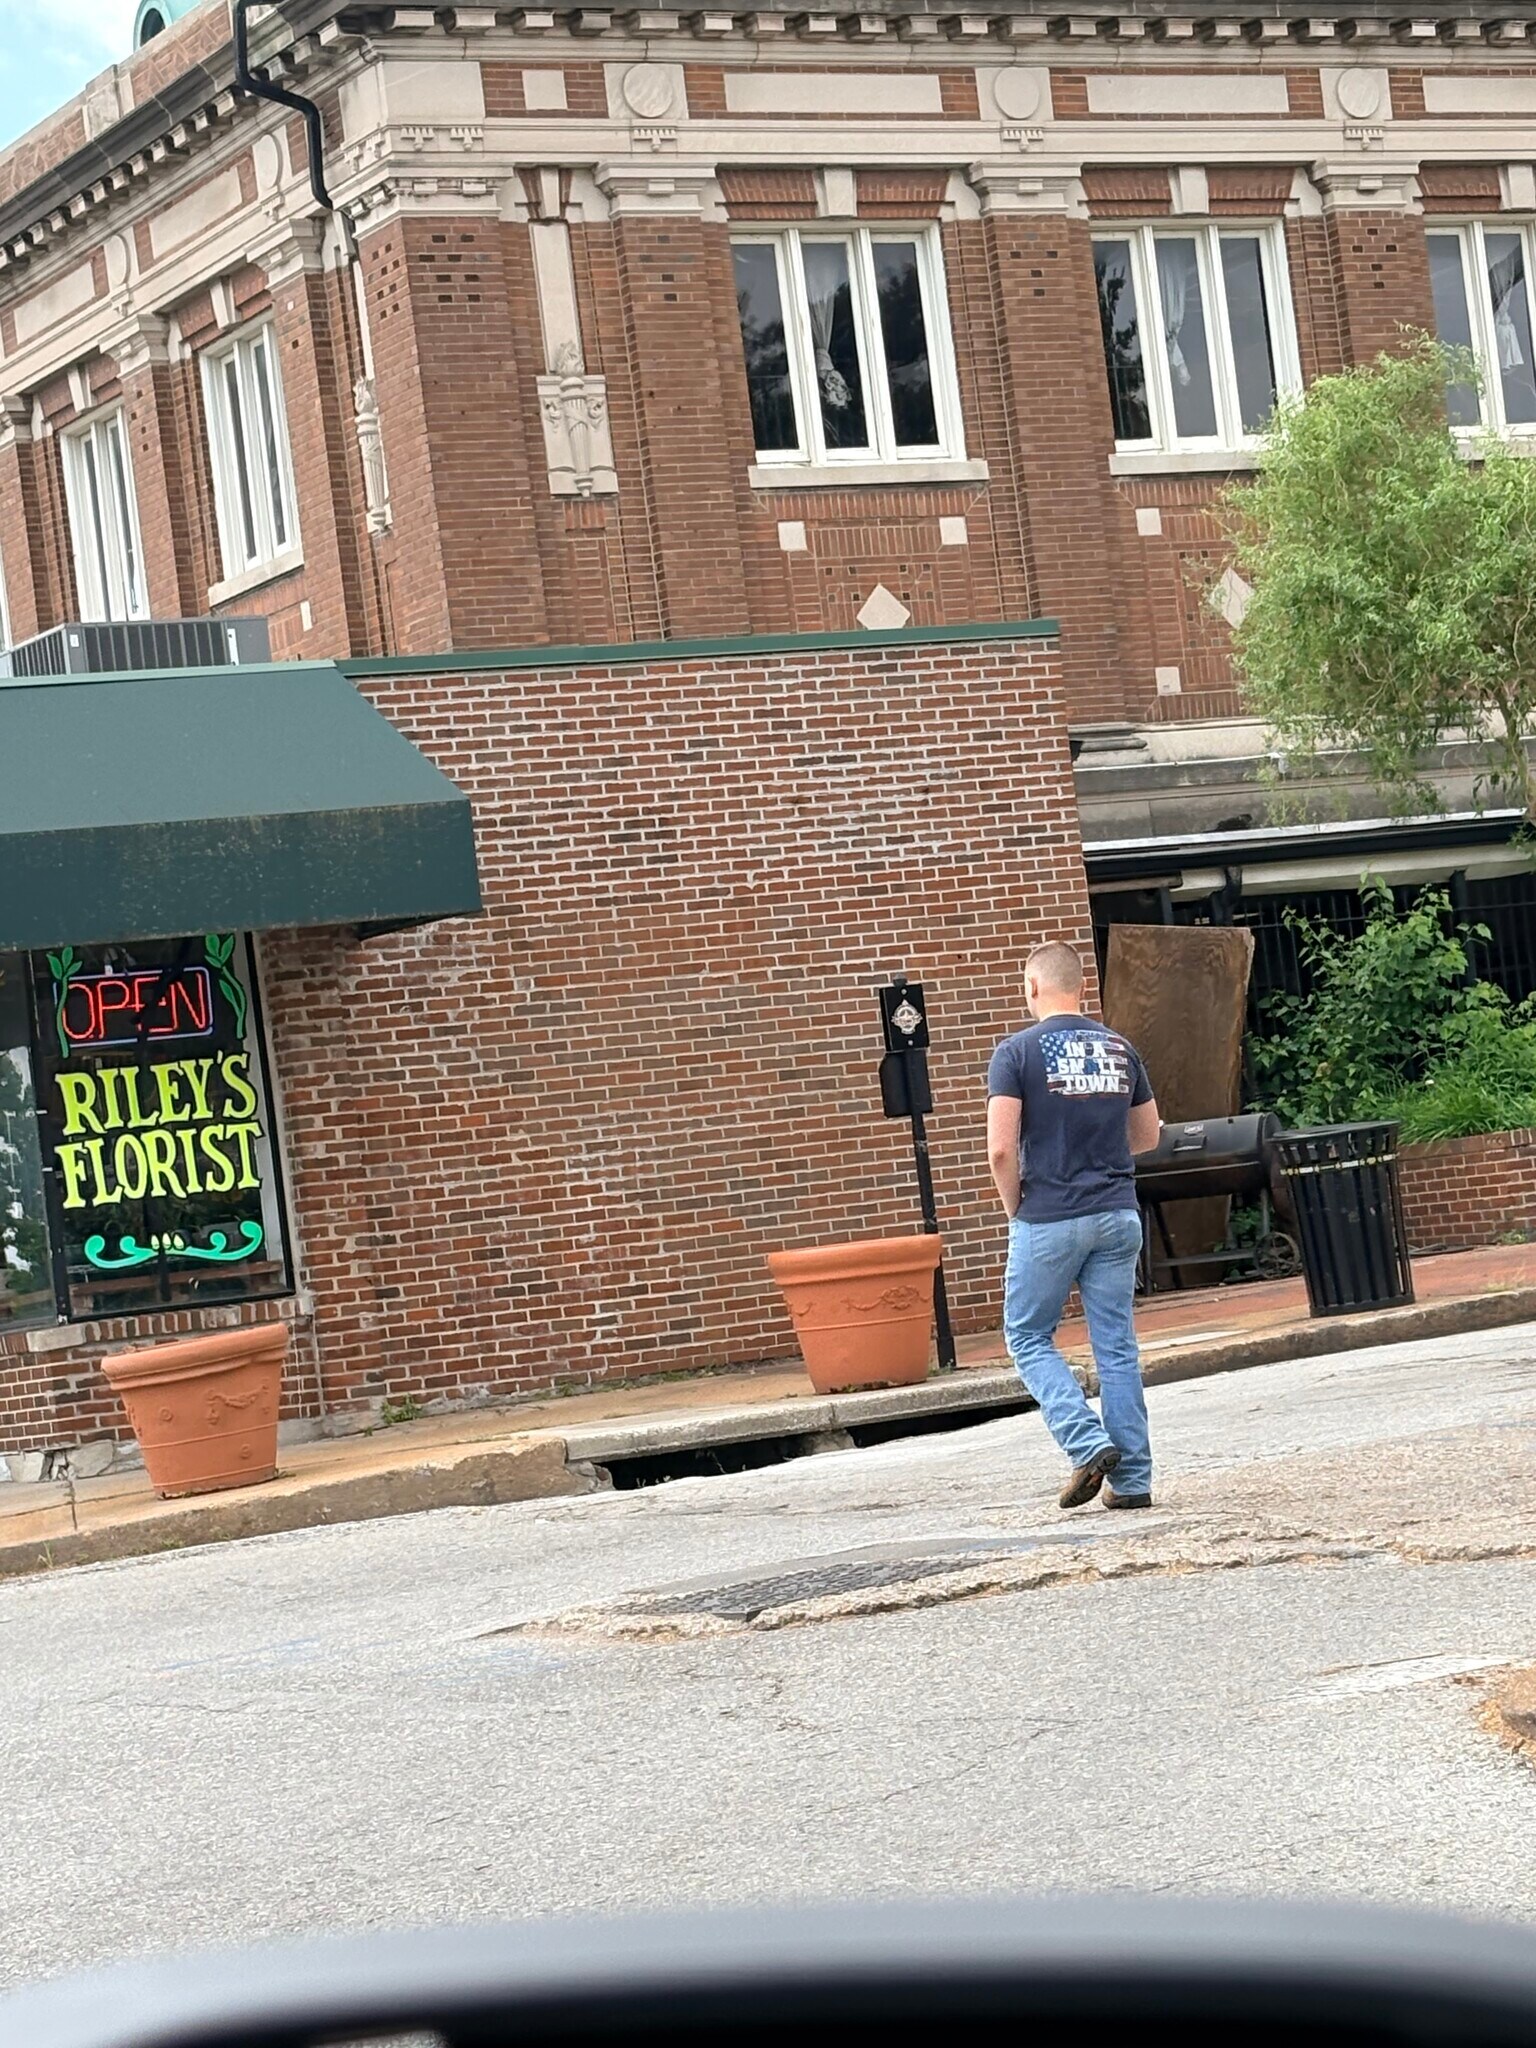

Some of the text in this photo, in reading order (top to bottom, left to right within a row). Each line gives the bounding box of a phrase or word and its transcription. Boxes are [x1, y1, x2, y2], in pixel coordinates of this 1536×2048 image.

[61, 973, 206, 1040] OPEN
[1063, 1041, 1107, 1057] IN A
[55, 1050, 257, 1136] RILEY'S
[1064, 1074, 1120, 1092] TOWN
[54, 1122, 263, 1209] FLORIST
